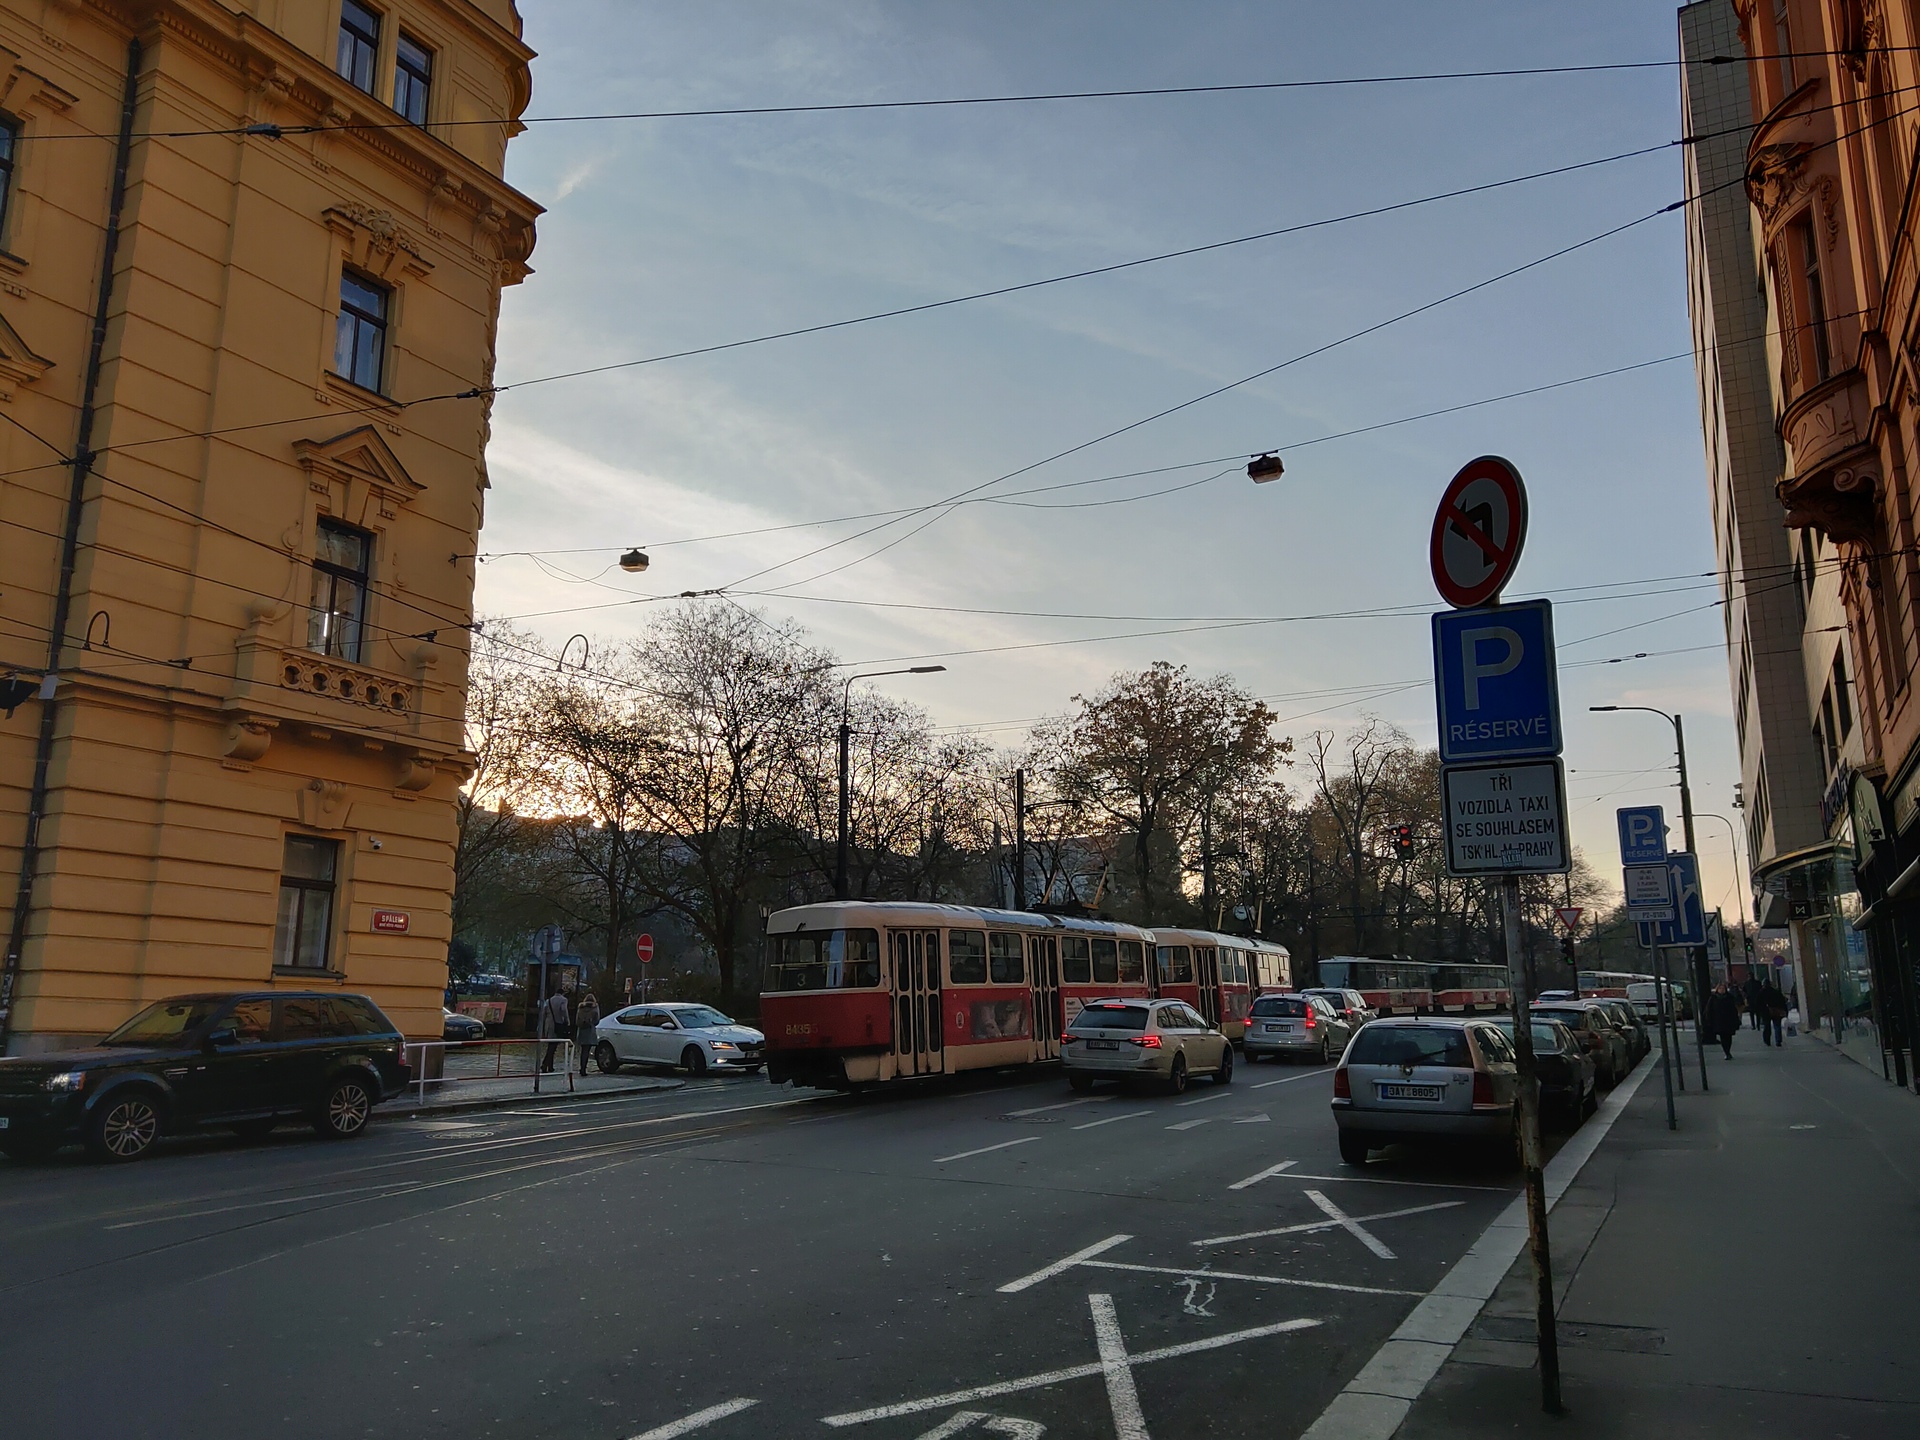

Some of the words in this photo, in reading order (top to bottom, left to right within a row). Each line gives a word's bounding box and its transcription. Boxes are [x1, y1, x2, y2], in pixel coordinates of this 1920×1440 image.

[1461, 626, 1524, 711] P
[1450, 714, 1548, 742] RÉSERVÉ
[1490, 773, 1512, 792] TŘI
[1458, 799, 1512, 816] VOZIDLA
[1519, 796, 1549, 812] TAXI
[1456, 822, 1473, 838] SE
[1476, 818, 1555, 837] SOUHLASEM
[1628, 814, 1654, 847] P
[1461, 844, 1481, 860] TSK
[1519, 841, 1554, 857] PRAHY
[1626, 849, 1663, 858] RÉSERVÉ
[797, 973, 806, 987] 3
